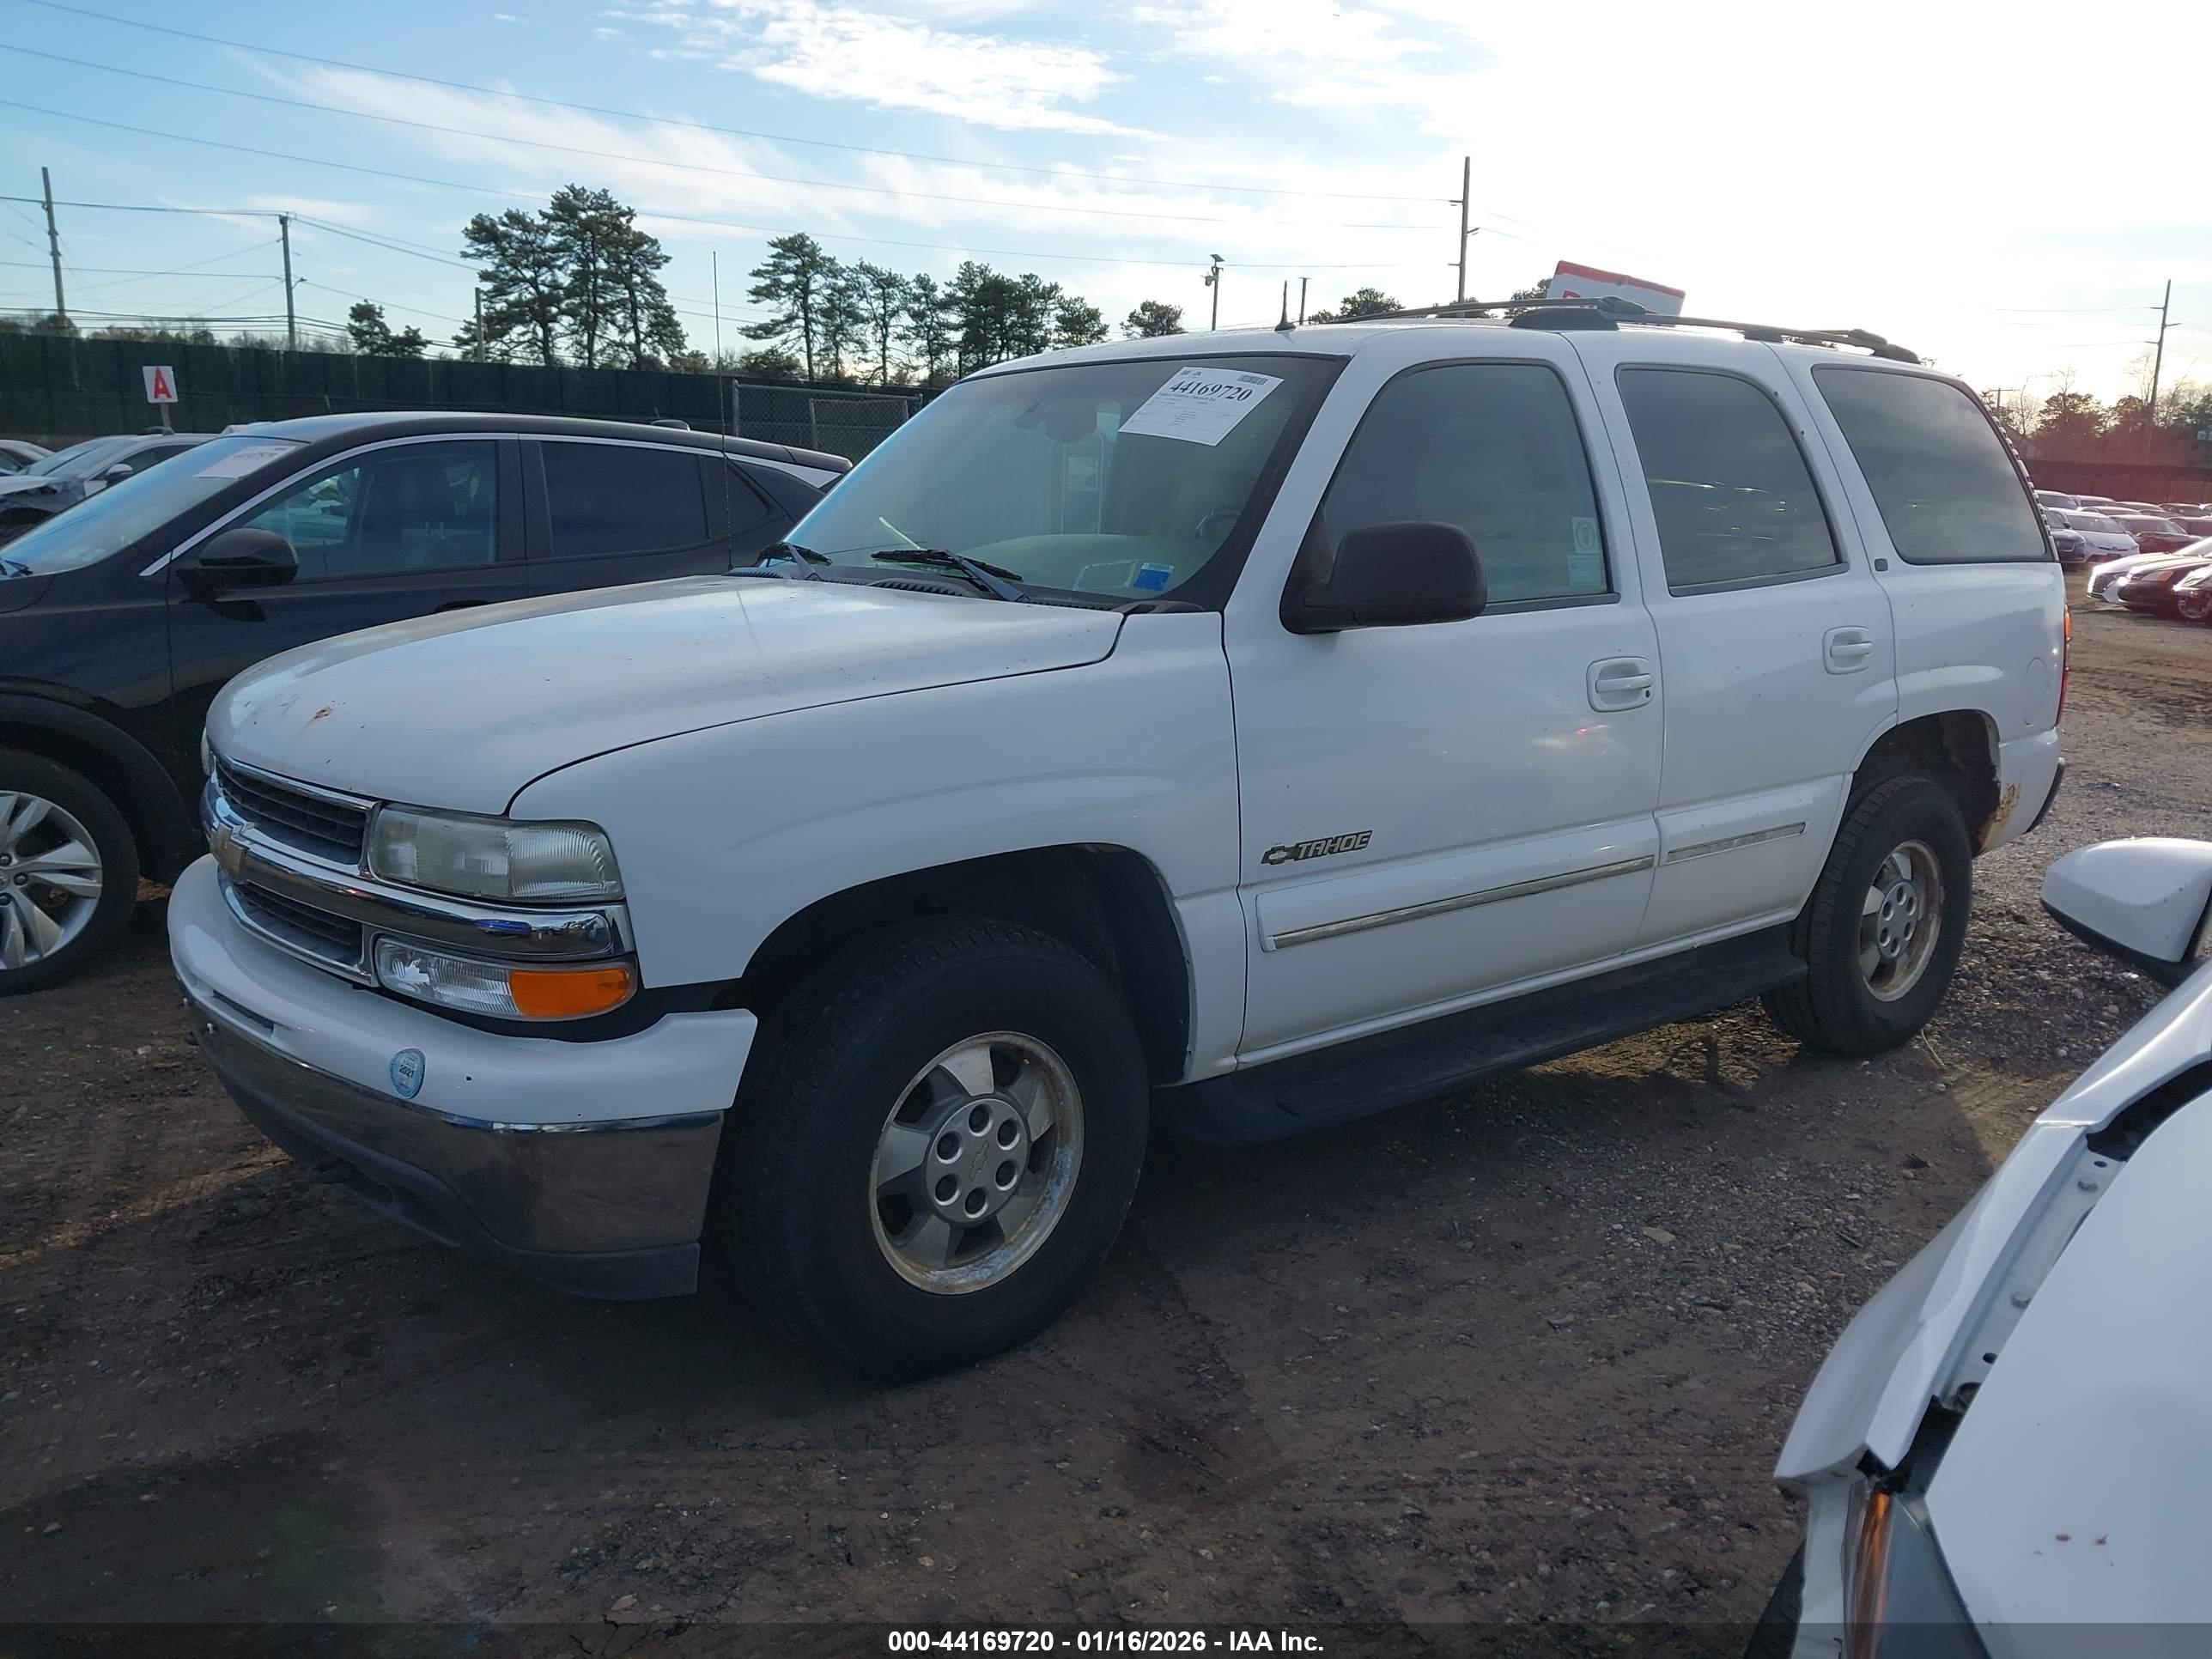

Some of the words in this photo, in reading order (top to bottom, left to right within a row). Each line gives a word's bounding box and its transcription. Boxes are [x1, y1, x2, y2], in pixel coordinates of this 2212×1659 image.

[153, 367, 173, 399] A
[1170, 380, 1254, 402] 44169720
[1296, 830, 1372, 860] TAHOE
